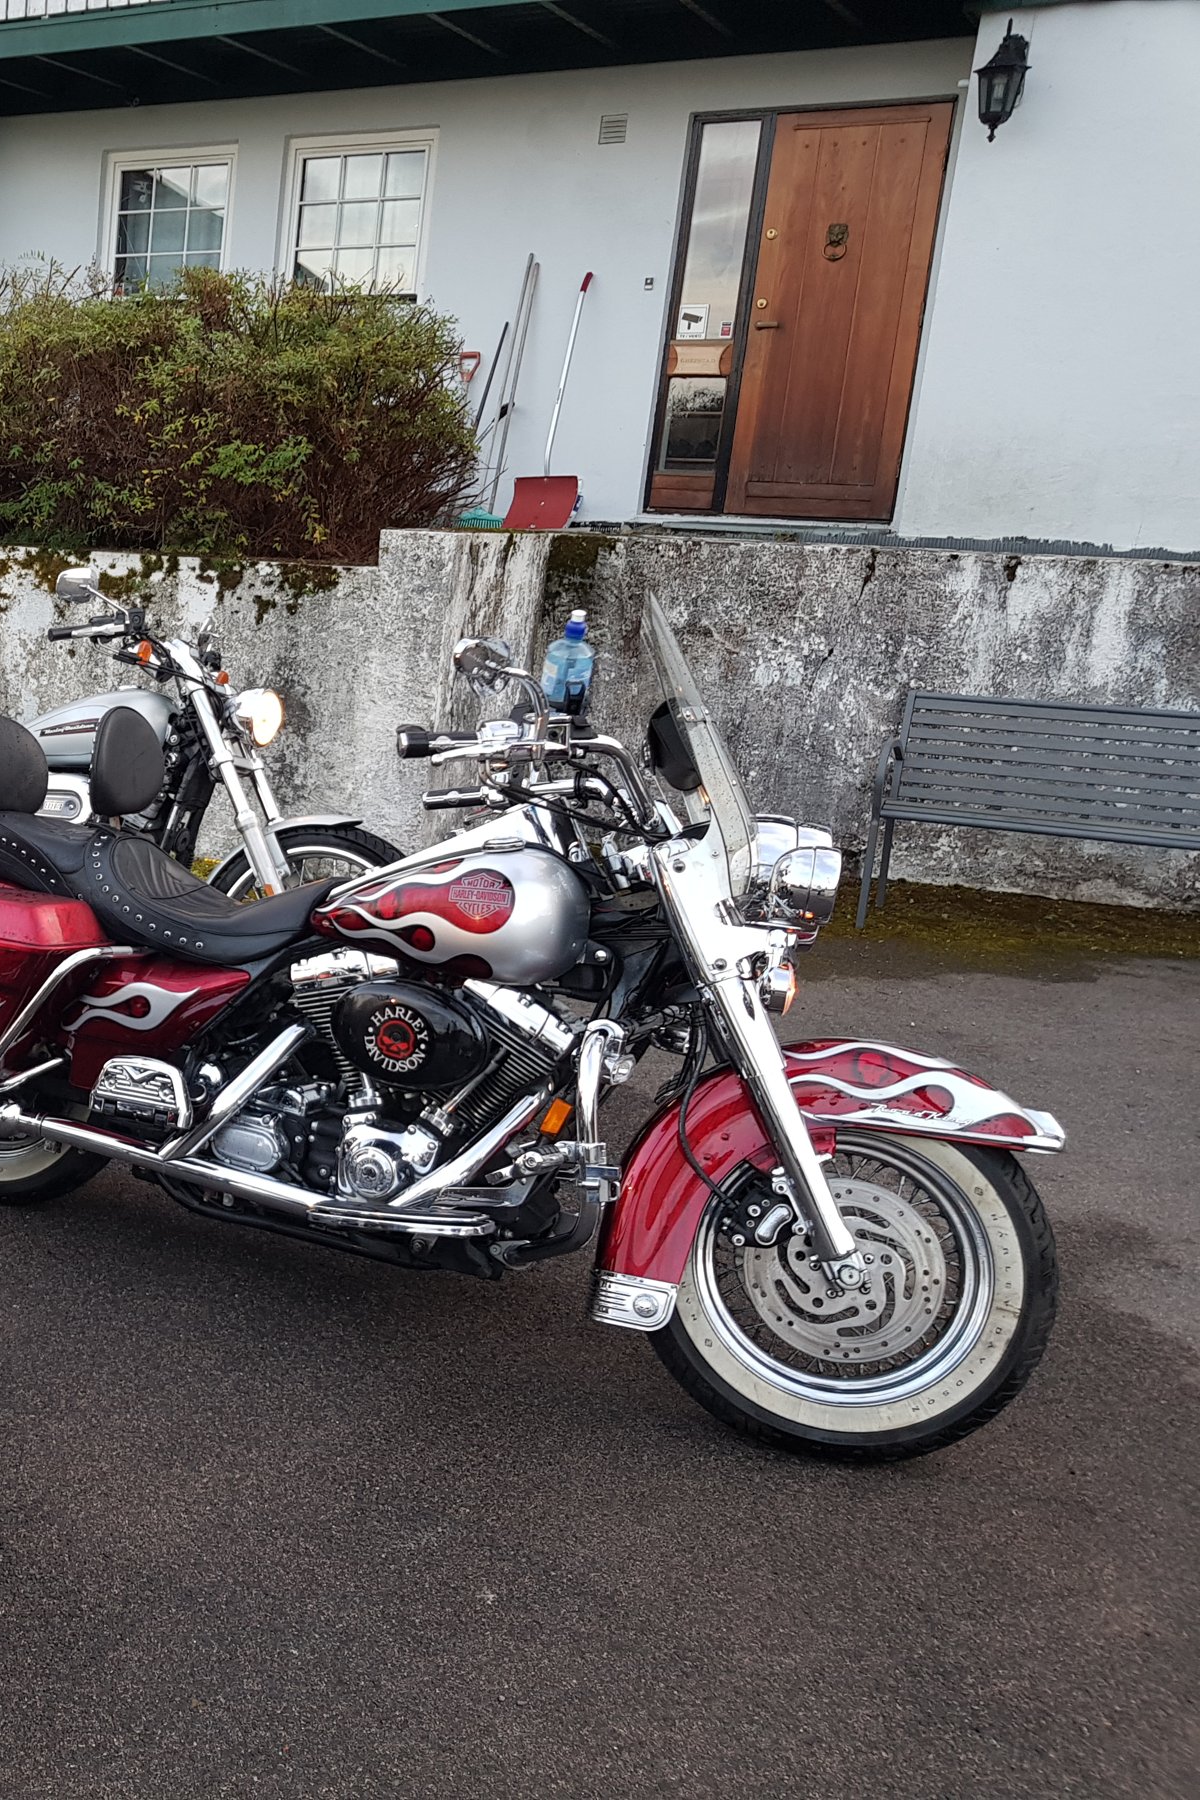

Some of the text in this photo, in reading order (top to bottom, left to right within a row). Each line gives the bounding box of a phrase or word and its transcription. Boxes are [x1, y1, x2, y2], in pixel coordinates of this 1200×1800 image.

[467, 878, 496, 889] MOTOR
[453, 889, 508, 903] HARLEY-DAVIDSON
[463, 903, 492, 913] CYCLES
[370, 1006, 429, 1042] HARLEY
[364, 1035, 426, 1073] DAVIDSON
